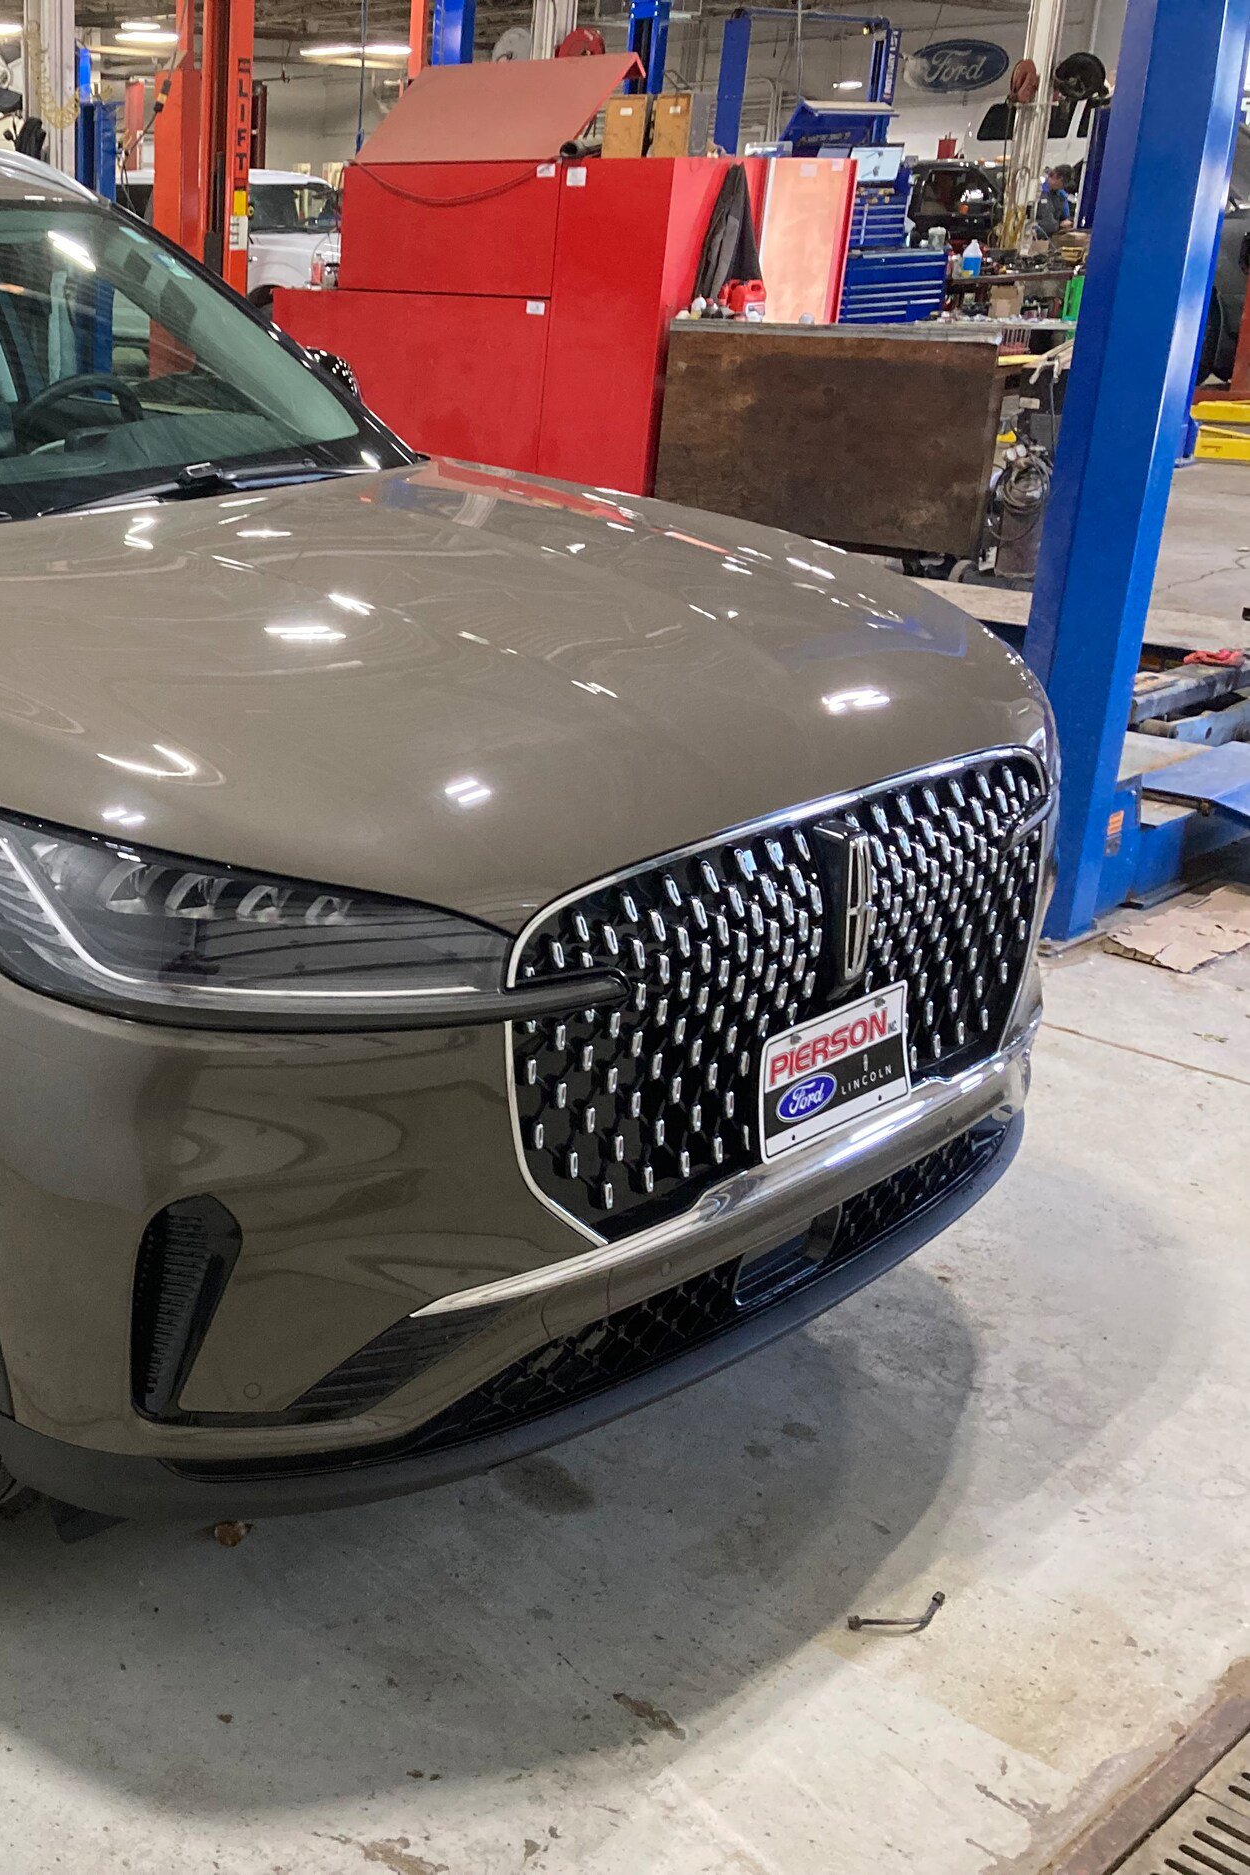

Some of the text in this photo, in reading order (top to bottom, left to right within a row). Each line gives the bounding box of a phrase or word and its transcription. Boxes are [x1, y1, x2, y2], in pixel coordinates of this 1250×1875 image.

[924, 50, 987, 83] Ford
[237, 78, 249, 171] LIFT
[768, 1007, 888, 1087] PIERSON
[841, 1064, 893, 1095] LINCOLN
[788, 1081, 826, 1115] Ford
